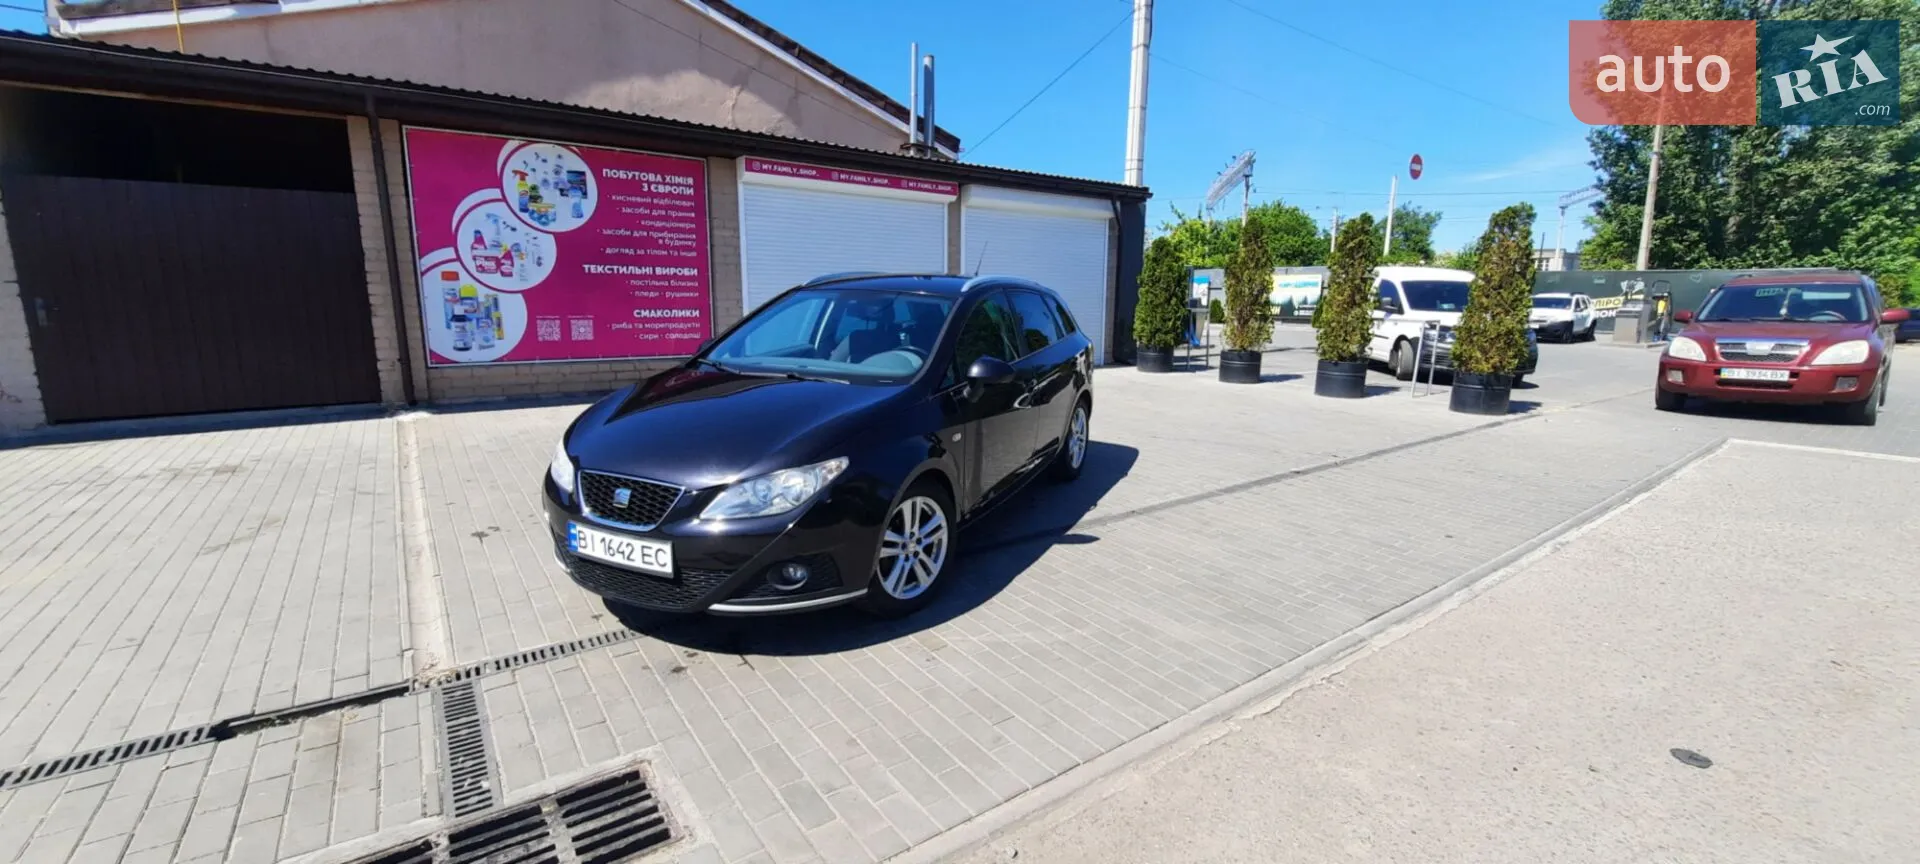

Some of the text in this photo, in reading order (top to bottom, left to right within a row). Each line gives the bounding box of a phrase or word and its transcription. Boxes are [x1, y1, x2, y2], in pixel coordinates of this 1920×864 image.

[602, 168, 694, 185] ПОБУТОВА ХІМІЯ
[642, 183, 694, 195] З ЄВРОПИ
[653, 197, 695, 207] відбілювач
[621, 207, 650, 215] засоби
[667, 210, 695, 218] прання
[641, 220, 696, 230] кондиціонери
[602, 228, 632, 236] засоби
[649, 230, 696, 239] прибирання
[665, 239, 696, 248] будинку
[605, 247, 634, 255] догляд
[646, 248, 668, 256] тілом
[582, 264, 698, 276] ТЕКСТИЛЬНІ ВИРОБИ
[630, 279, 699, 287] постільна білизна
[665, 291, 699, 299] рушники
[633, 309, 700, 318] СМАКОЛИКИ
[611, 322, 633, 330] риба
[645, 322, 700, 330] морепродукти
[577, 530, 667, 568] BI 1642 EC
